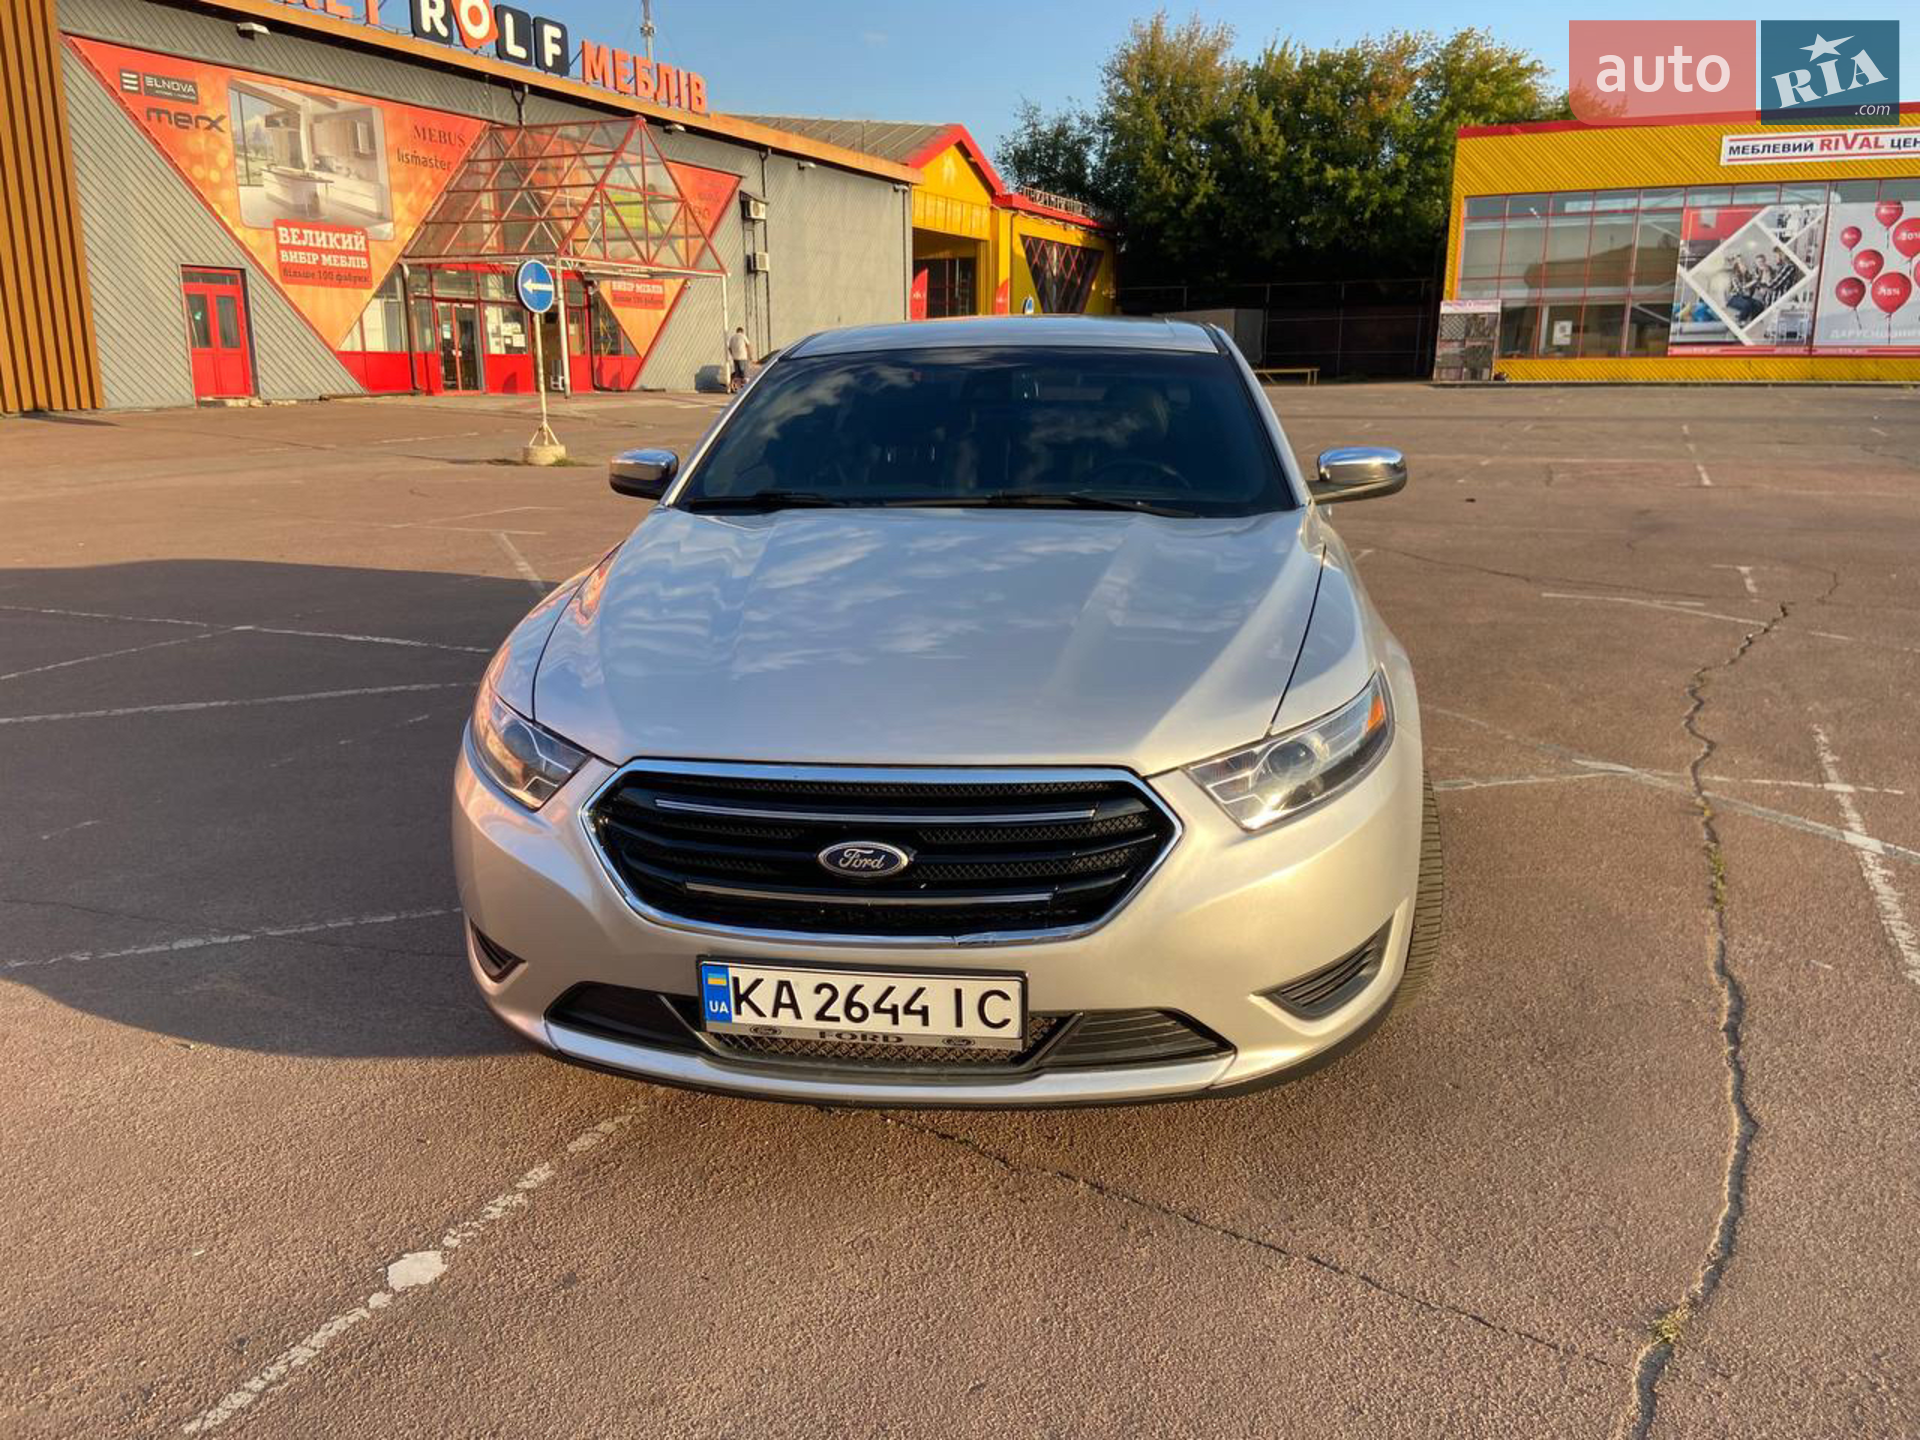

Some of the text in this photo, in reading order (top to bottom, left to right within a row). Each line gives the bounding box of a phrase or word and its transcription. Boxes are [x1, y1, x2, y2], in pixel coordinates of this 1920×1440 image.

[420, 0, 562, 67] ROLF
[144, 75, 196, 94] ELNOVA
[581, 40, 707, 114] МЕБЛІВ
[147, 107, 227, 133] merx
[413, 125, 466, 148] MEBUS
[1728, 139, 1815, 156] МЕБЛЕВИЙ
[278, 227, 366, 251] ВЕЛИКИЙ
[281, 250, 368, 269] ВИБІР МЕБЛІВ
[838, 849, 885, 869] Ford
[709, 1000, 729, 1013] UA
[732, 976, 1012, 1028] KA 2644 IC
